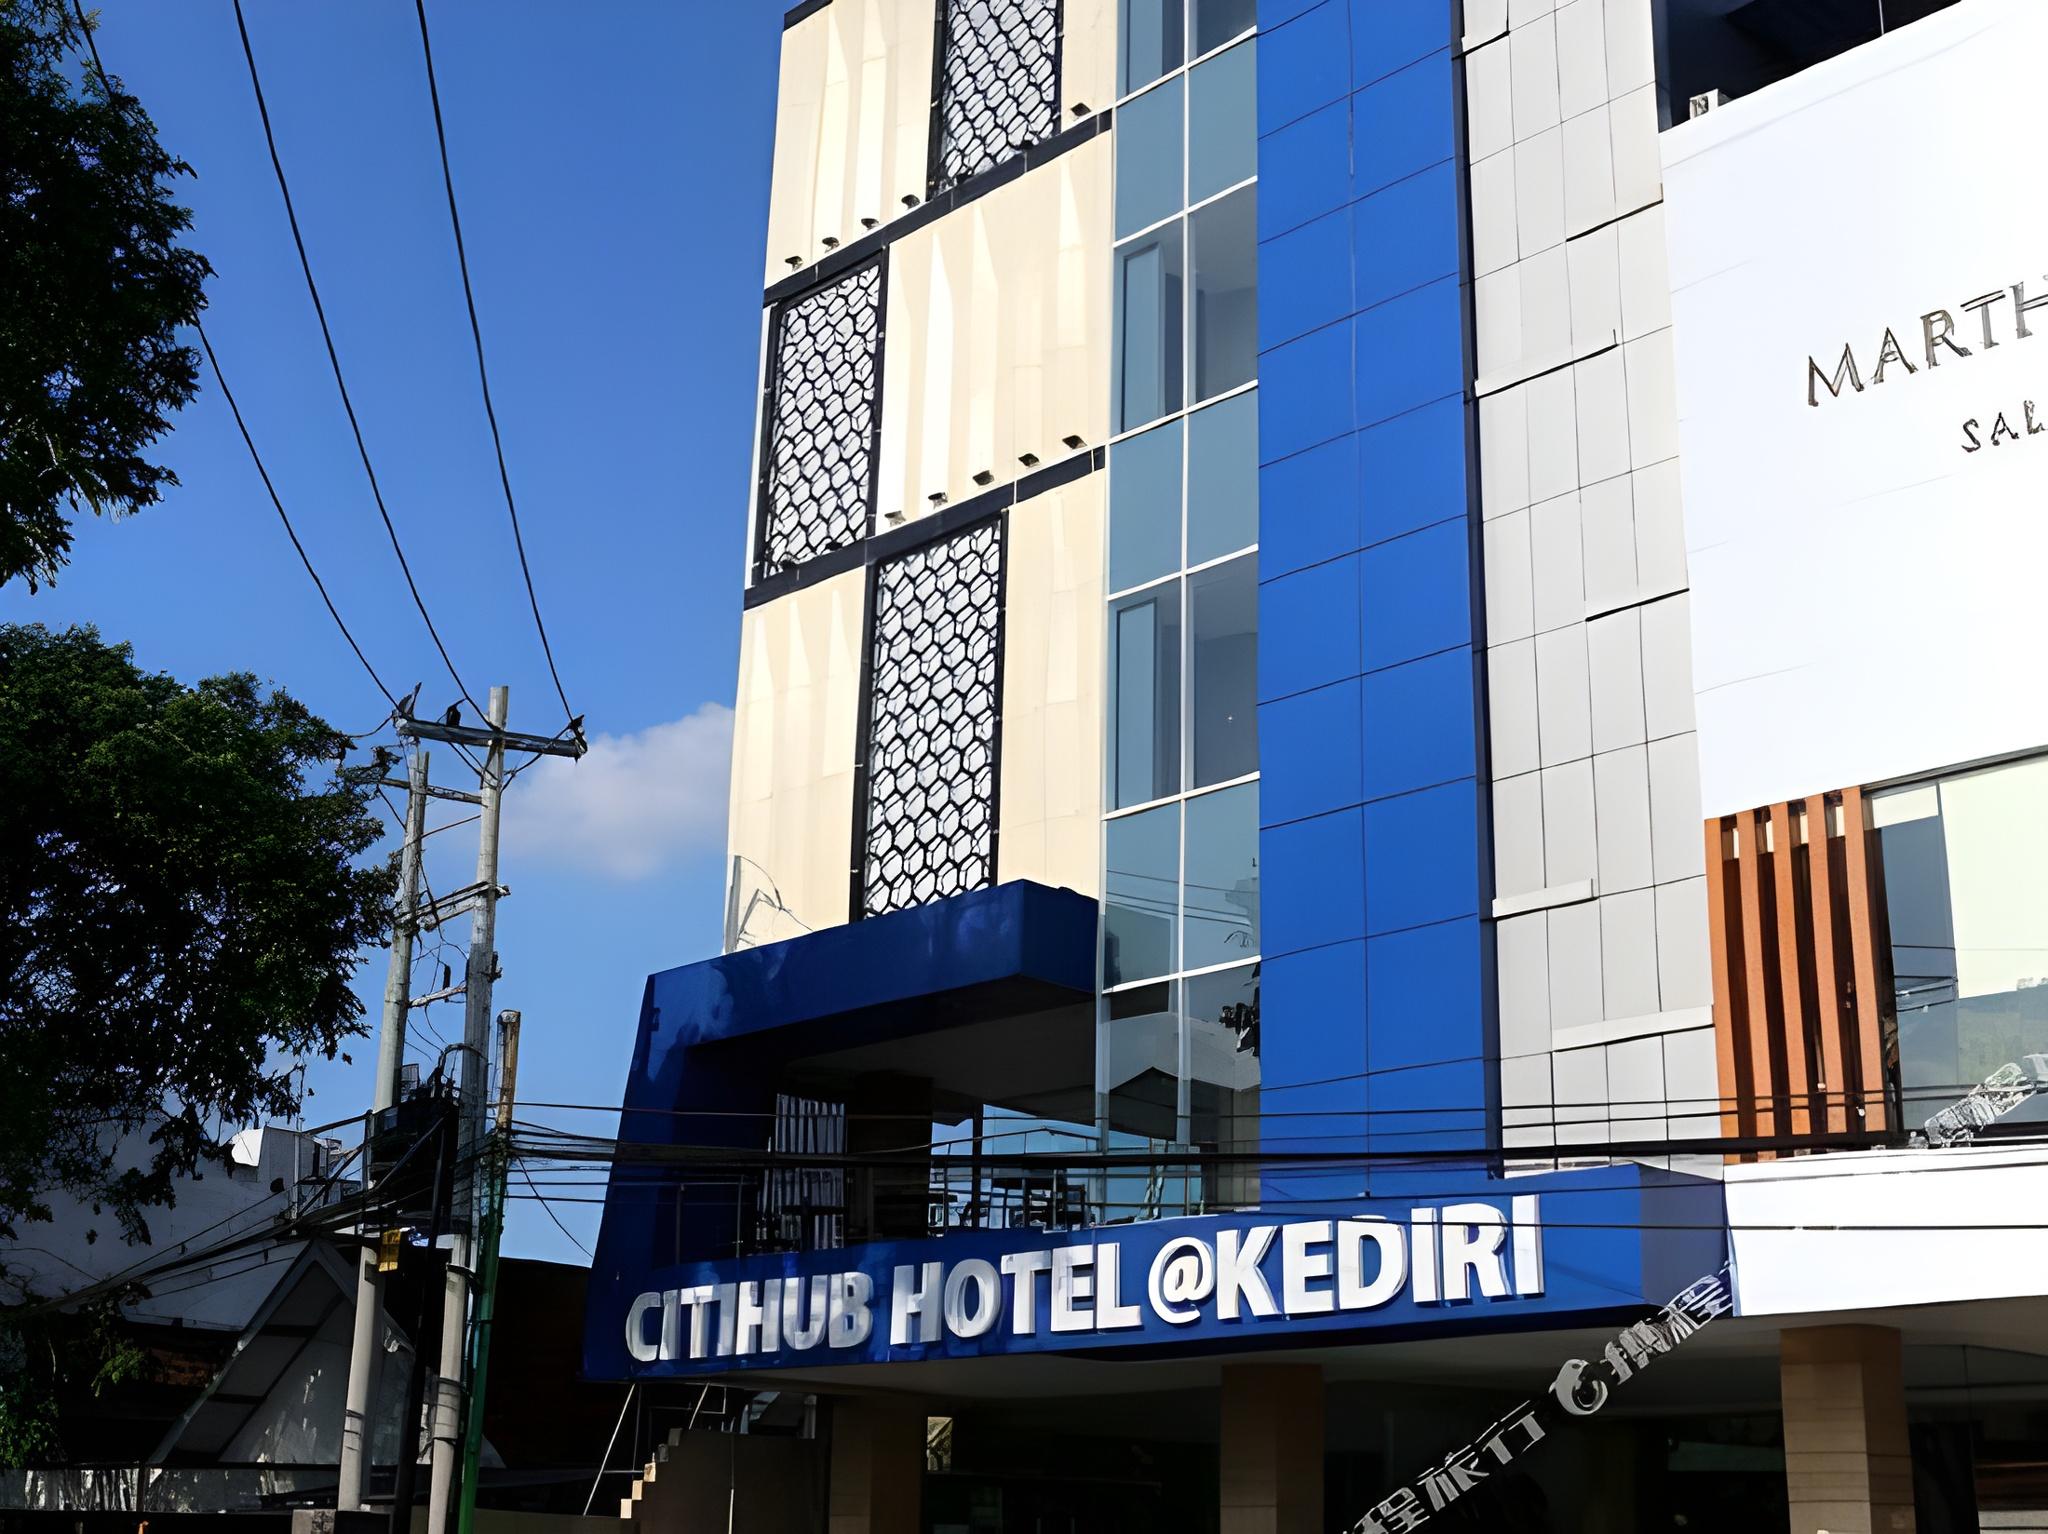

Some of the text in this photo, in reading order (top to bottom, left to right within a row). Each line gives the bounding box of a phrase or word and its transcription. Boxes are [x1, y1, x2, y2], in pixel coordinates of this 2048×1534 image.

[626, 1194, 1546, 1362] CITIHUB HOTEL @KEDIRI
